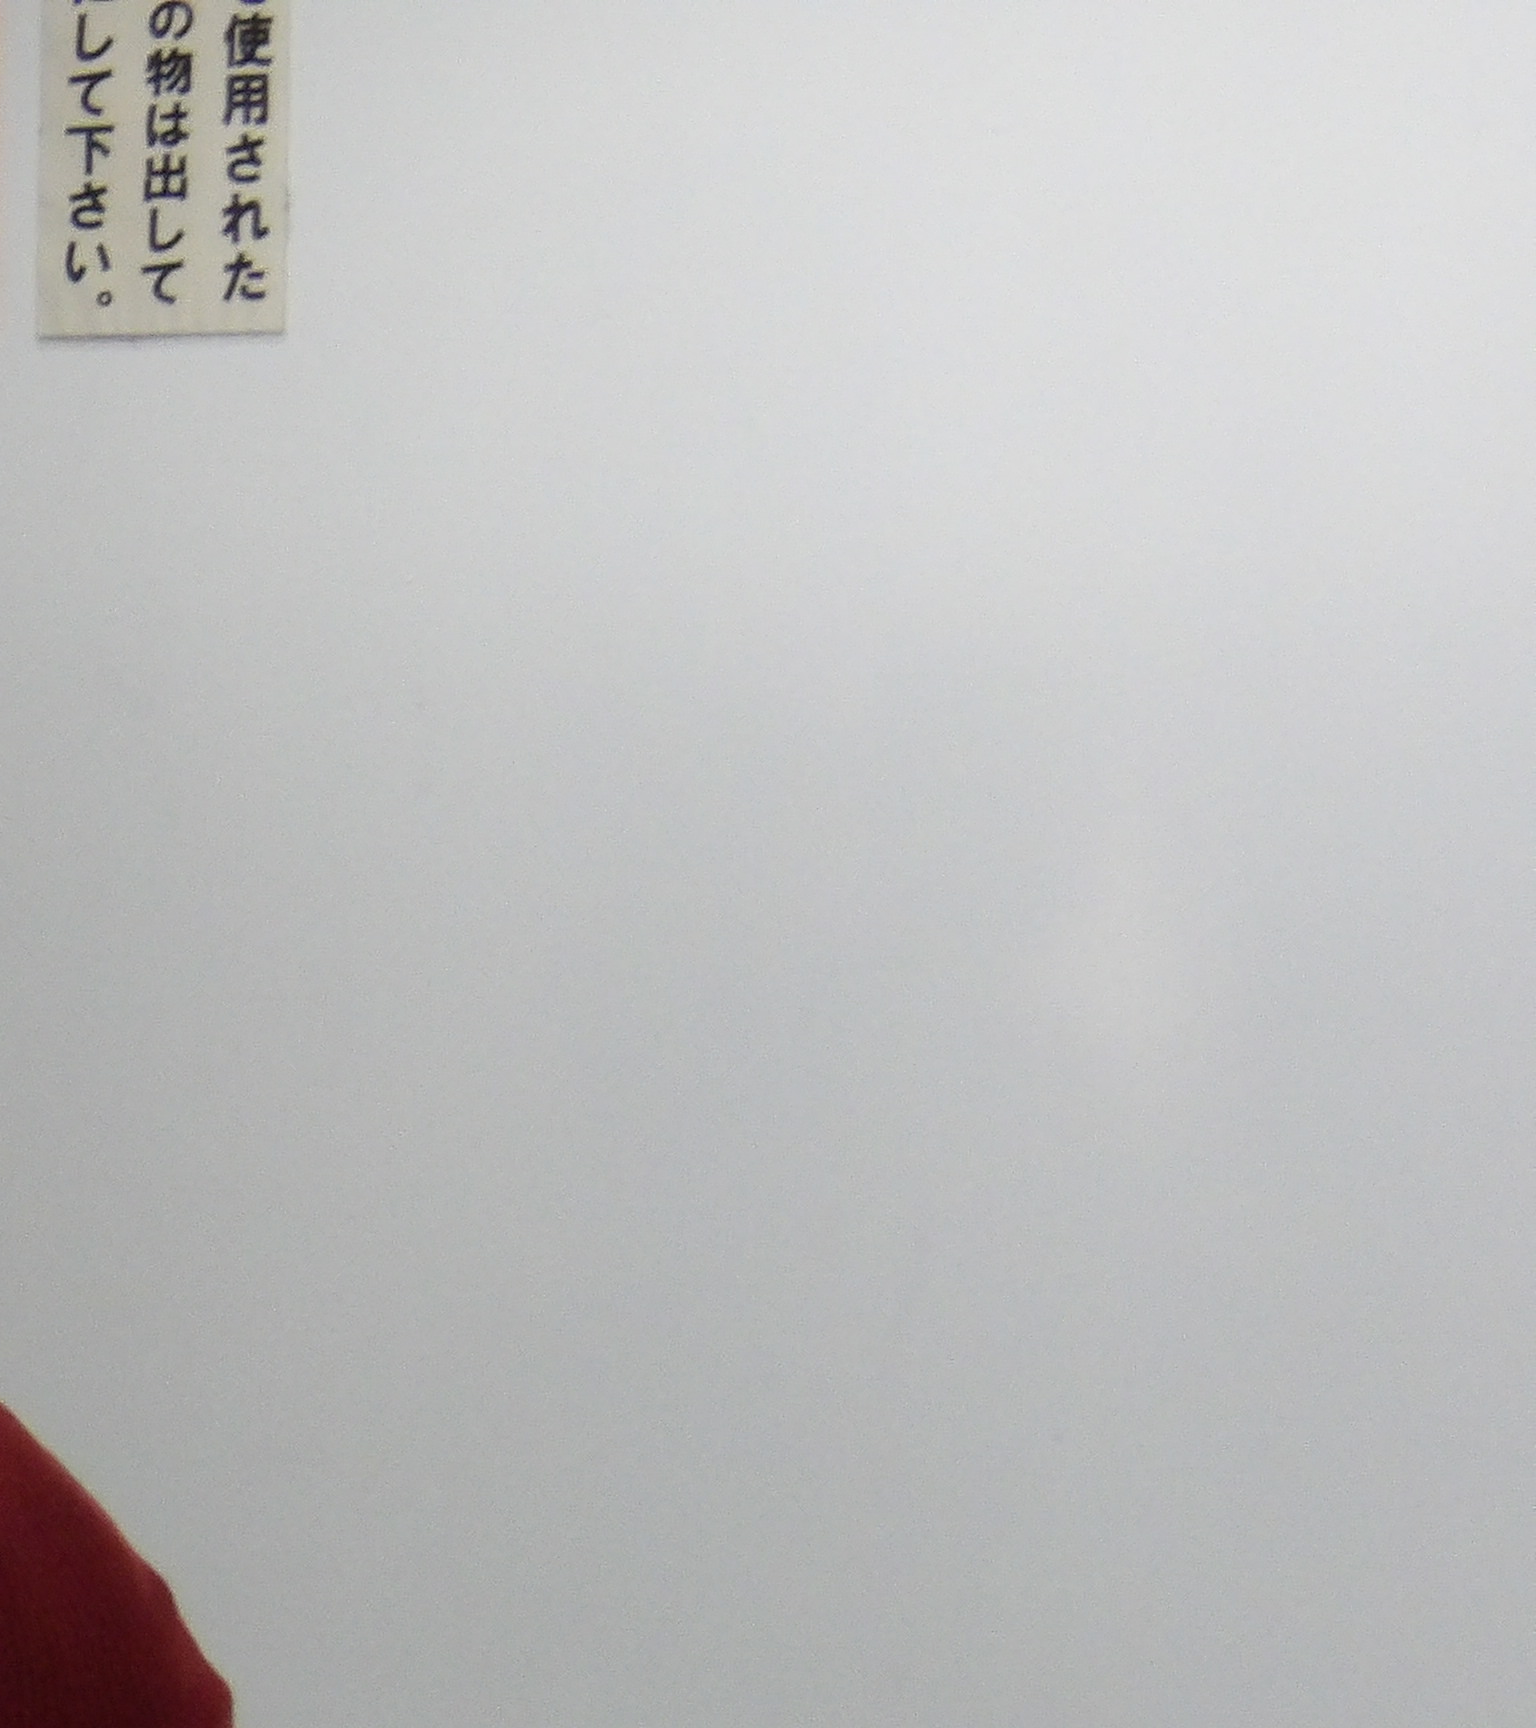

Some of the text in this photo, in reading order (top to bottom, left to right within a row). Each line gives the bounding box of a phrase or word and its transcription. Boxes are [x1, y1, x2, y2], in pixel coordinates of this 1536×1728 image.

[65, 0, 115, 307] して下さい。
[141, 0, 193, 304] の物は出して
[222, 0, 274, 301] 使用された
